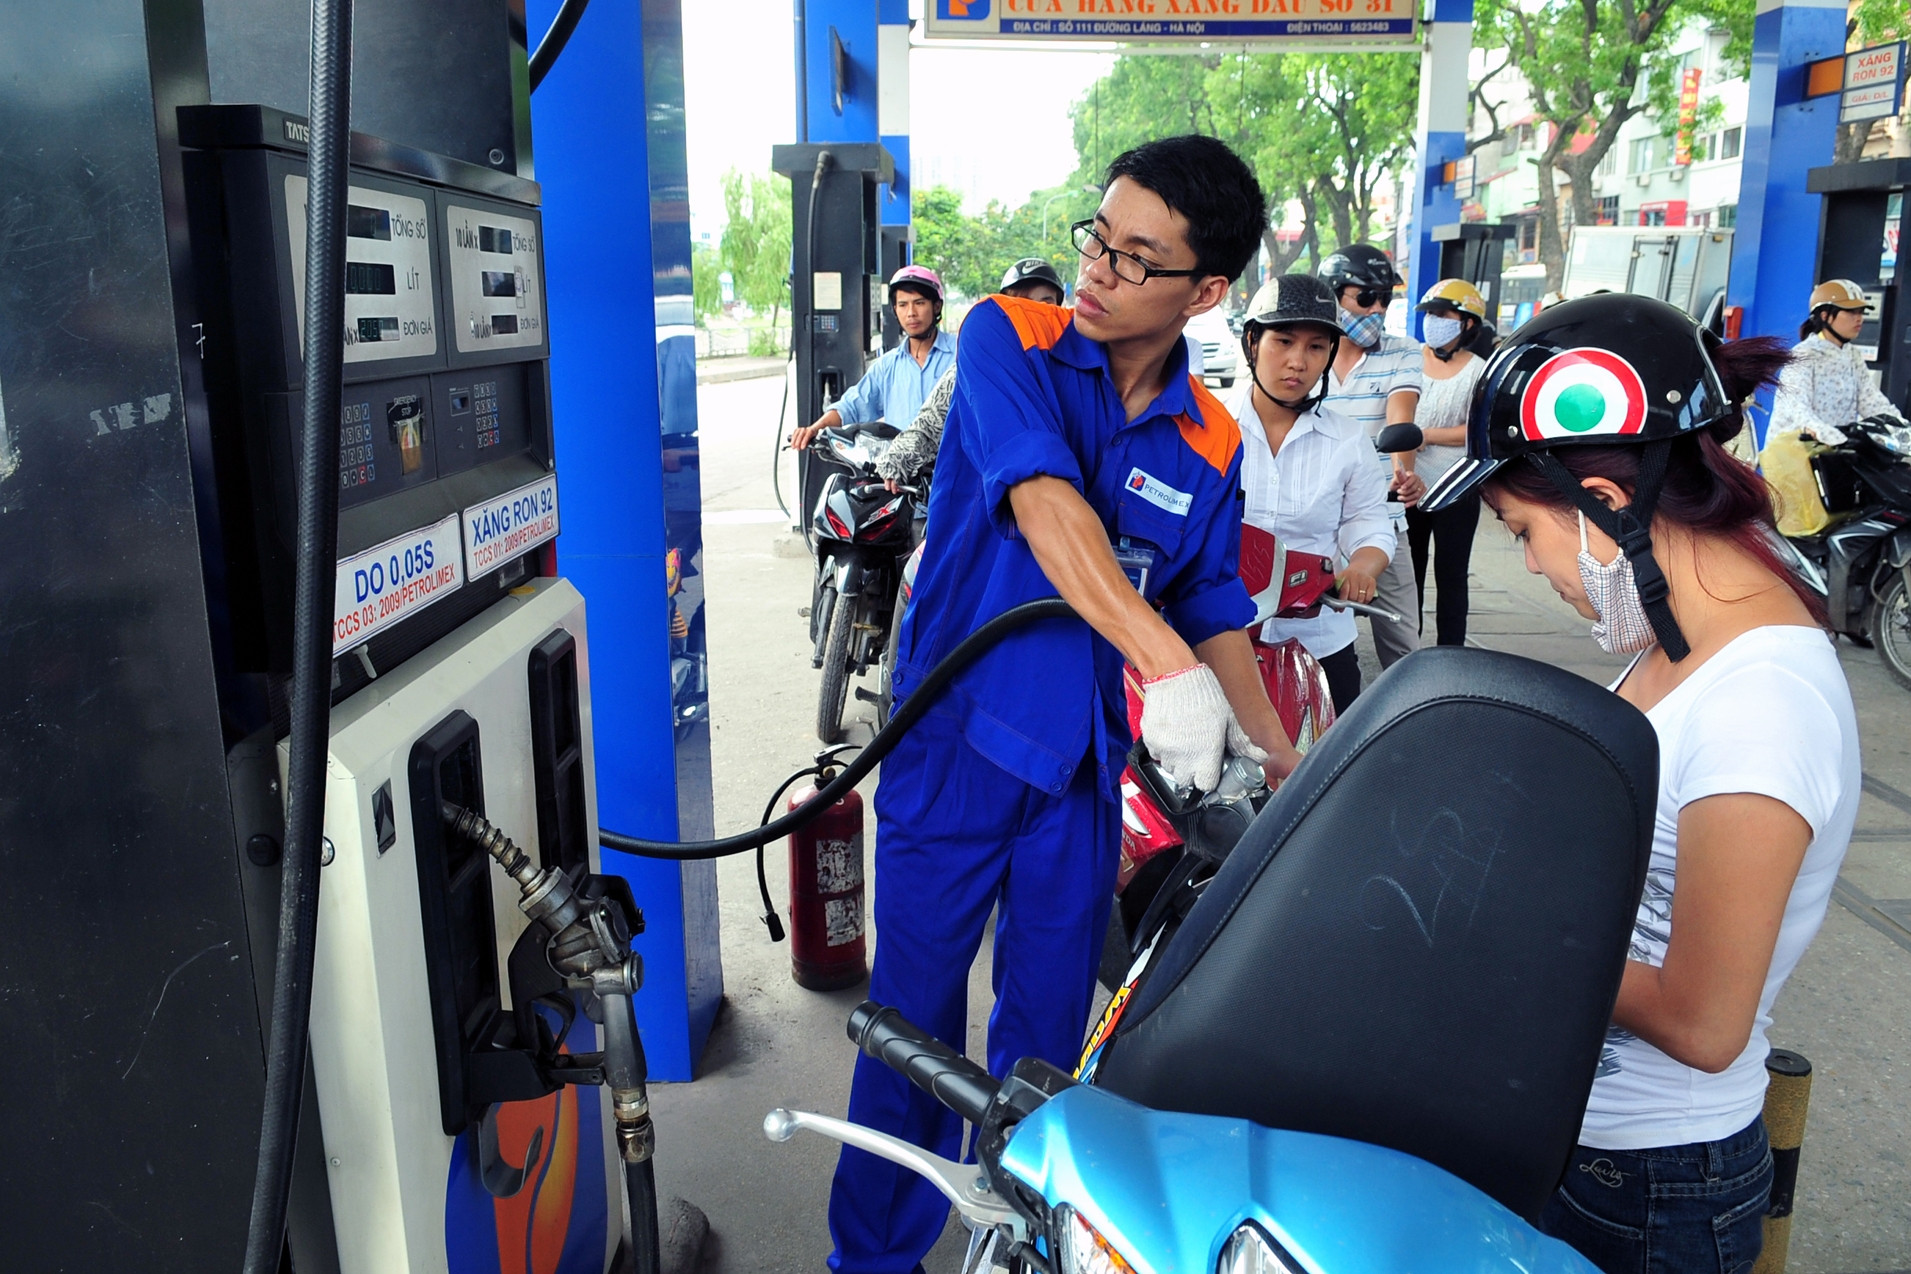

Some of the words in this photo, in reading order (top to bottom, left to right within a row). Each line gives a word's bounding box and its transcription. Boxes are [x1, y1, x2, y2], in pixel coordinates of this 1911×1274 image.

[1076, 22, 1091, 32] 111
[1852, 68, 1877, 82] RON
[1880, 65, 1895, 77] 92
[391, 213, 414, 237] TỔNG
[416, 218, 427, 239] SỐ
[407, 266, 420, 290] LÍT
[420, 316, 433, 335] GIÁ
[472, 507, 511, 547] XĂNG
[513, 493, 539, 527] RON
[541, 487, 553, 513] 92
[473, 545, 493, 569] TCCS
[355, 562, 384, 603] DO
[390, 540, 434, 587] 0,05S
[379, 563, 455, 618] 2009/PETROLIMEX
